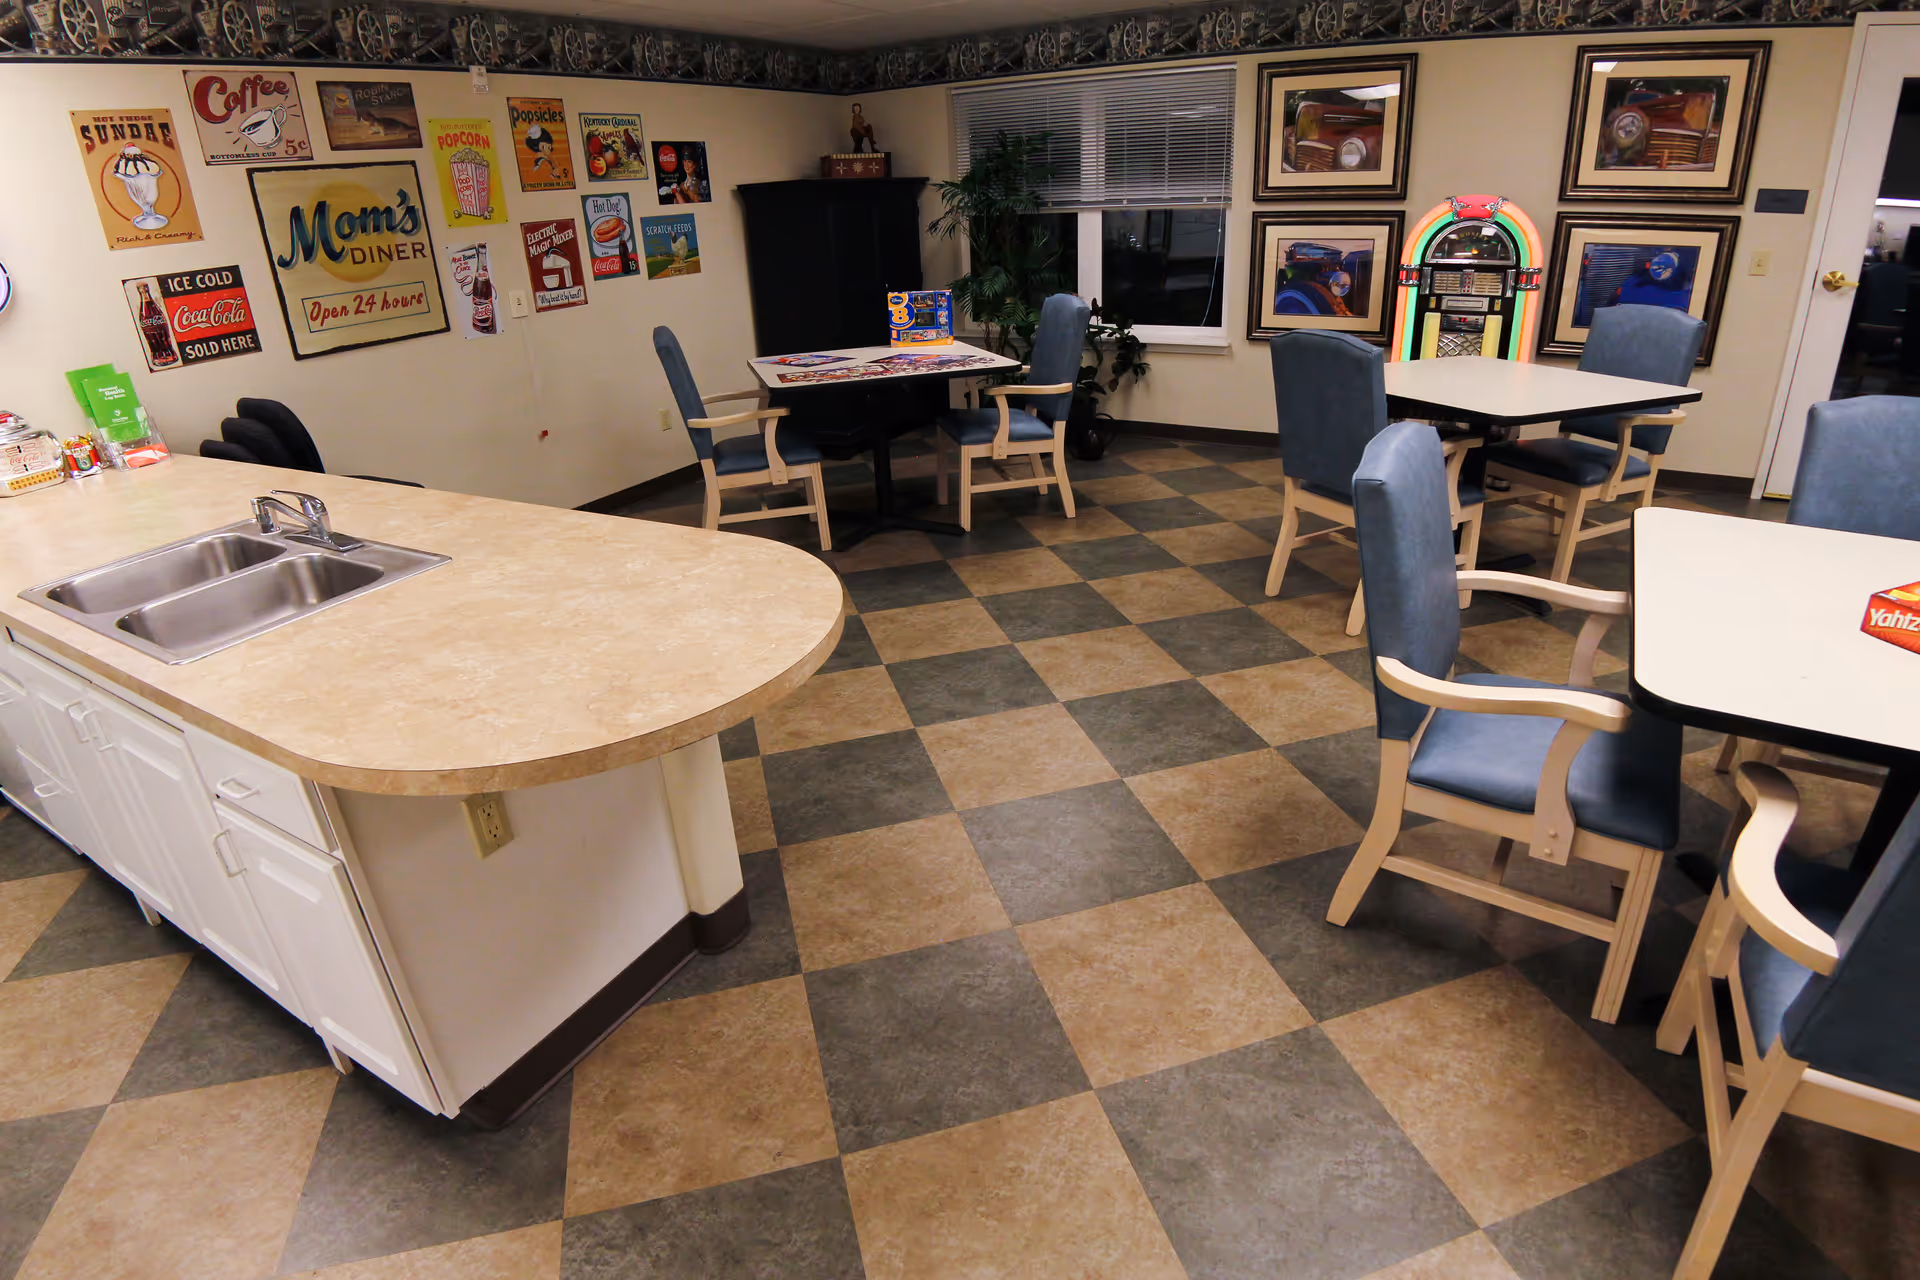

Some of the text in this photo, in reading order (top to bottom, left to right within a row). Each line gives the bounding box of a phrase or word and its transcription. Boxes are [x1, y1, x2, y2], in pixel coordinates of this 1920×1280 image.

[193, 74, 289, 124] Coffee
[92, 115, 114, 123] HOT
[511, 106, 565, 128] Popsicles
[80, 122, 176, 155] SUNDAE
[285, 139, 308, 156] 5¢
[438, 131, 490, 150] POPCORN
[593, 200, 606, 213] Hot
[116, 231, 197, 244] Rich & Creamy
[277, 189, 422, 270] Mom's
[526, 222, 558, 245] ELECTRIC
[646, 222, 692, 235] SCRATCH FEEDS
[351, 241, 427, 265] DINER
[528, 229, 574, 257] MAGIC MIXER
[168, 271, 233, 293] ICE COLD
[173, 297, 247, 333] Coca-Cola
[309, 291, 424, 327] Open 24 hours
[892, 307, 909, 323] 8
[185, 334, 255, 359] SOLD HERE
